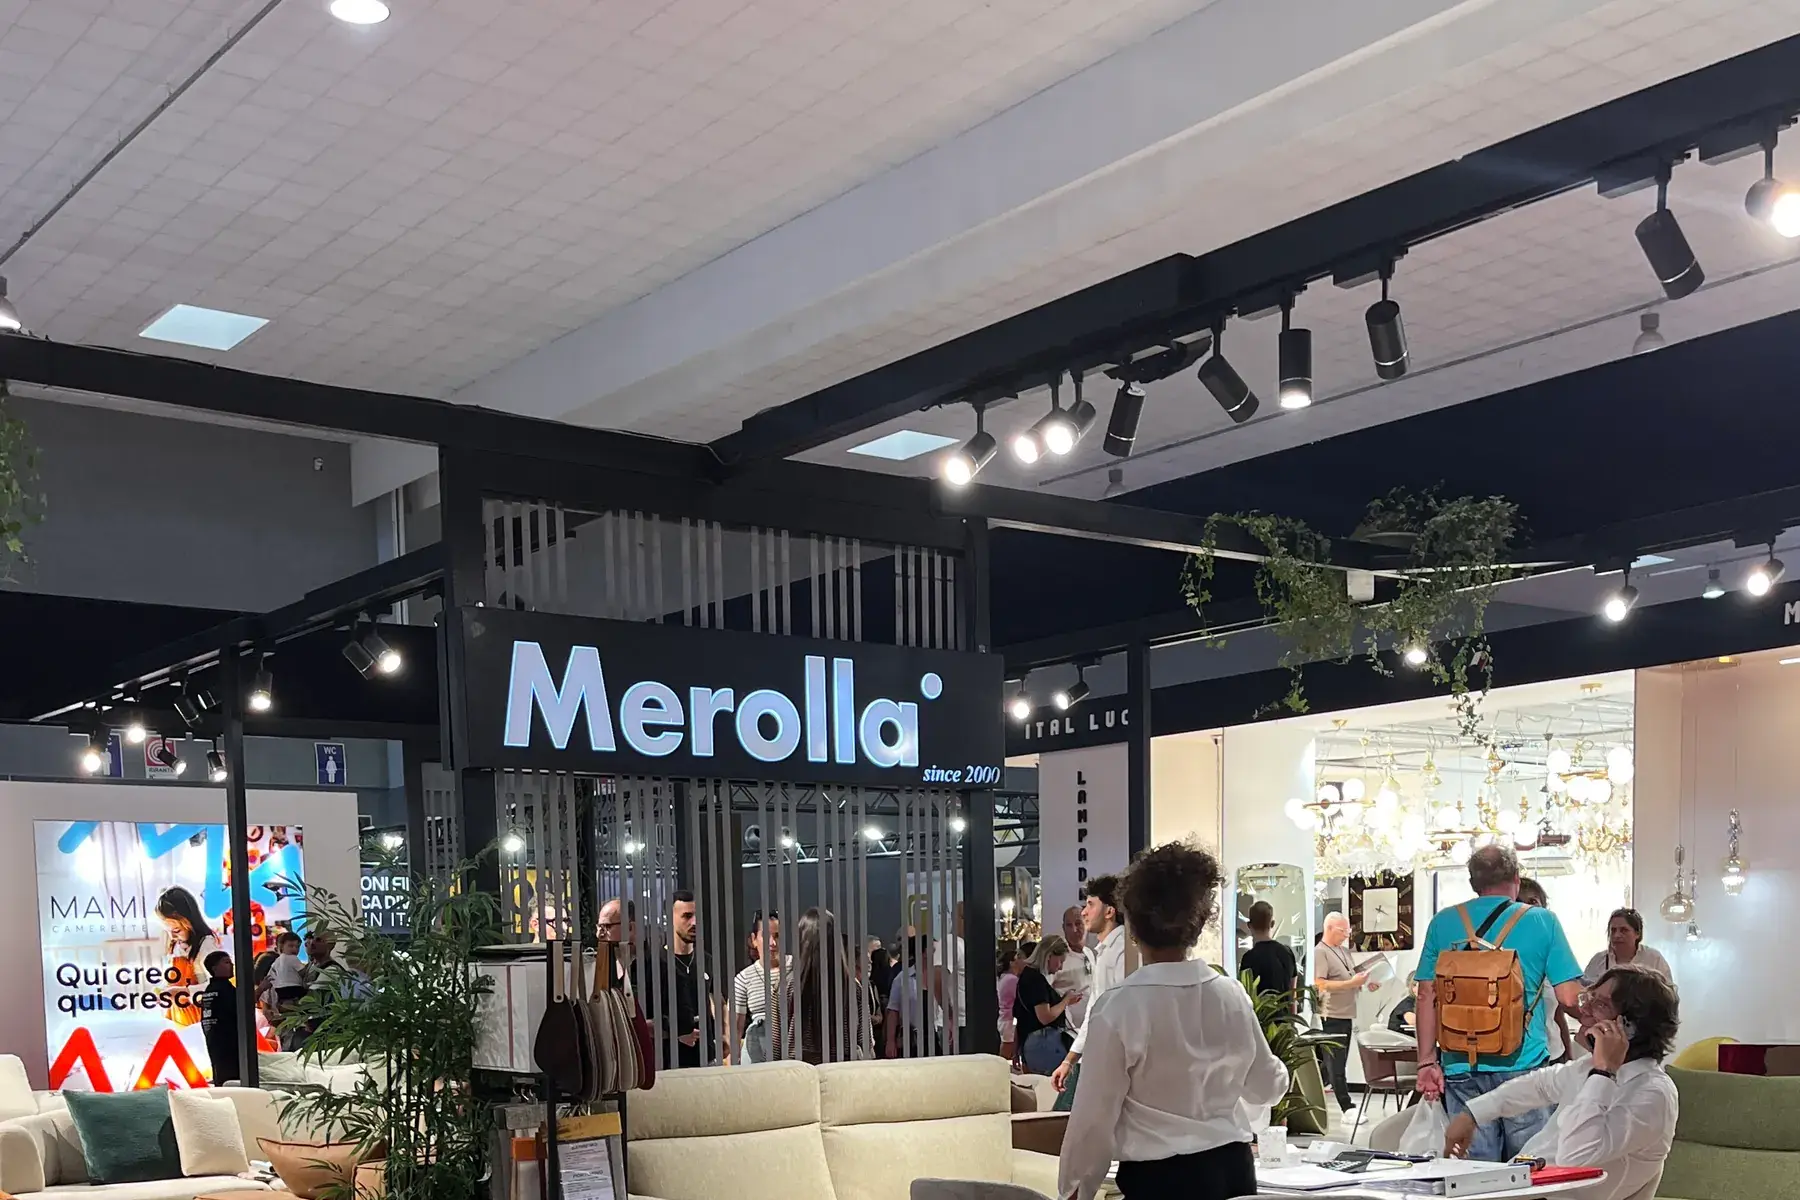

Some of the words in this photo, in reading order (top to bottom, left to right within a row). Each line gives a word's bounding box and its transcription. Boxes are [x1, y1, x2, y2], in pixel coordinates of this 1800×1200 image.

[503, 639, 921, 769] Merolla
[1025, 717, 1075, 740] ITAL
[323, 746, 337, 755] WC
[923, 764, 962, 783] since
[964, 764, 1001, 784] 2000
[51, 896, 147, 919] MAMI
[52, 924, 148, 934] CAMERETTE
[56, 962, 108, 989] Qui
[115, 965, 191, 988] creo,
[57, 989, 104, 1018] qui
